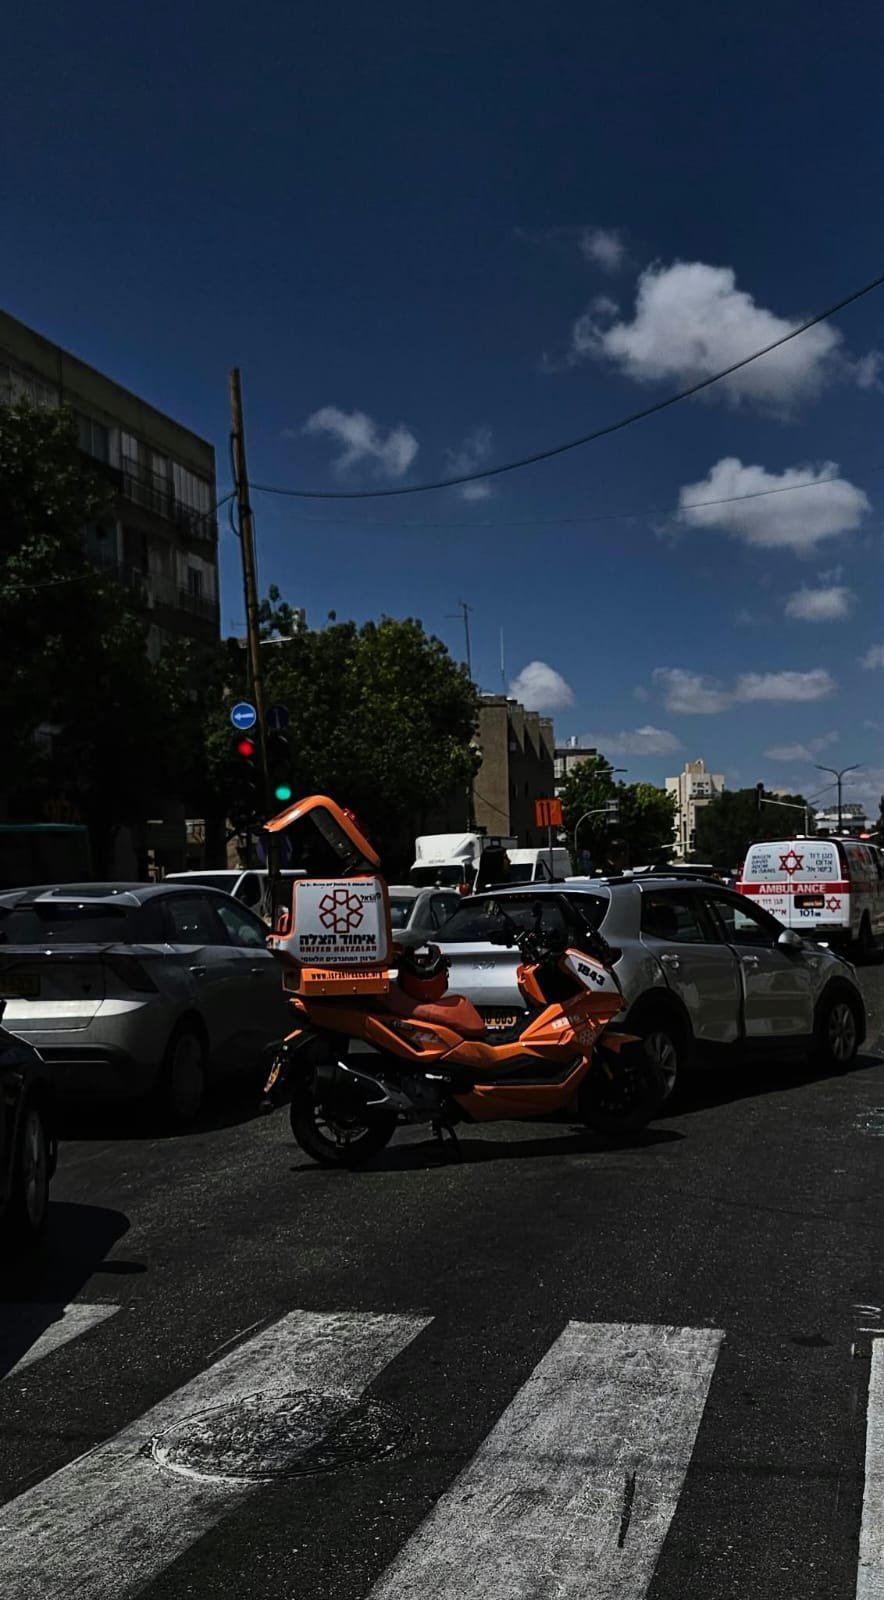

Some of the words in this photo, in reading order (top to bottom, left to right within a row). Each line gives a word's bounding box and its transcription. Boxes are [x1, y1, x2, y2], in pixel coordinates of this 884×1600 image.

[759, 884, 827, 894] AMBULANCE
[800, 908, 815, 917] 101
[300, 934, 337, 945] הצלה
[340, 934, 376, 945] איחוד
[577, 962, 605, 986] 1843
